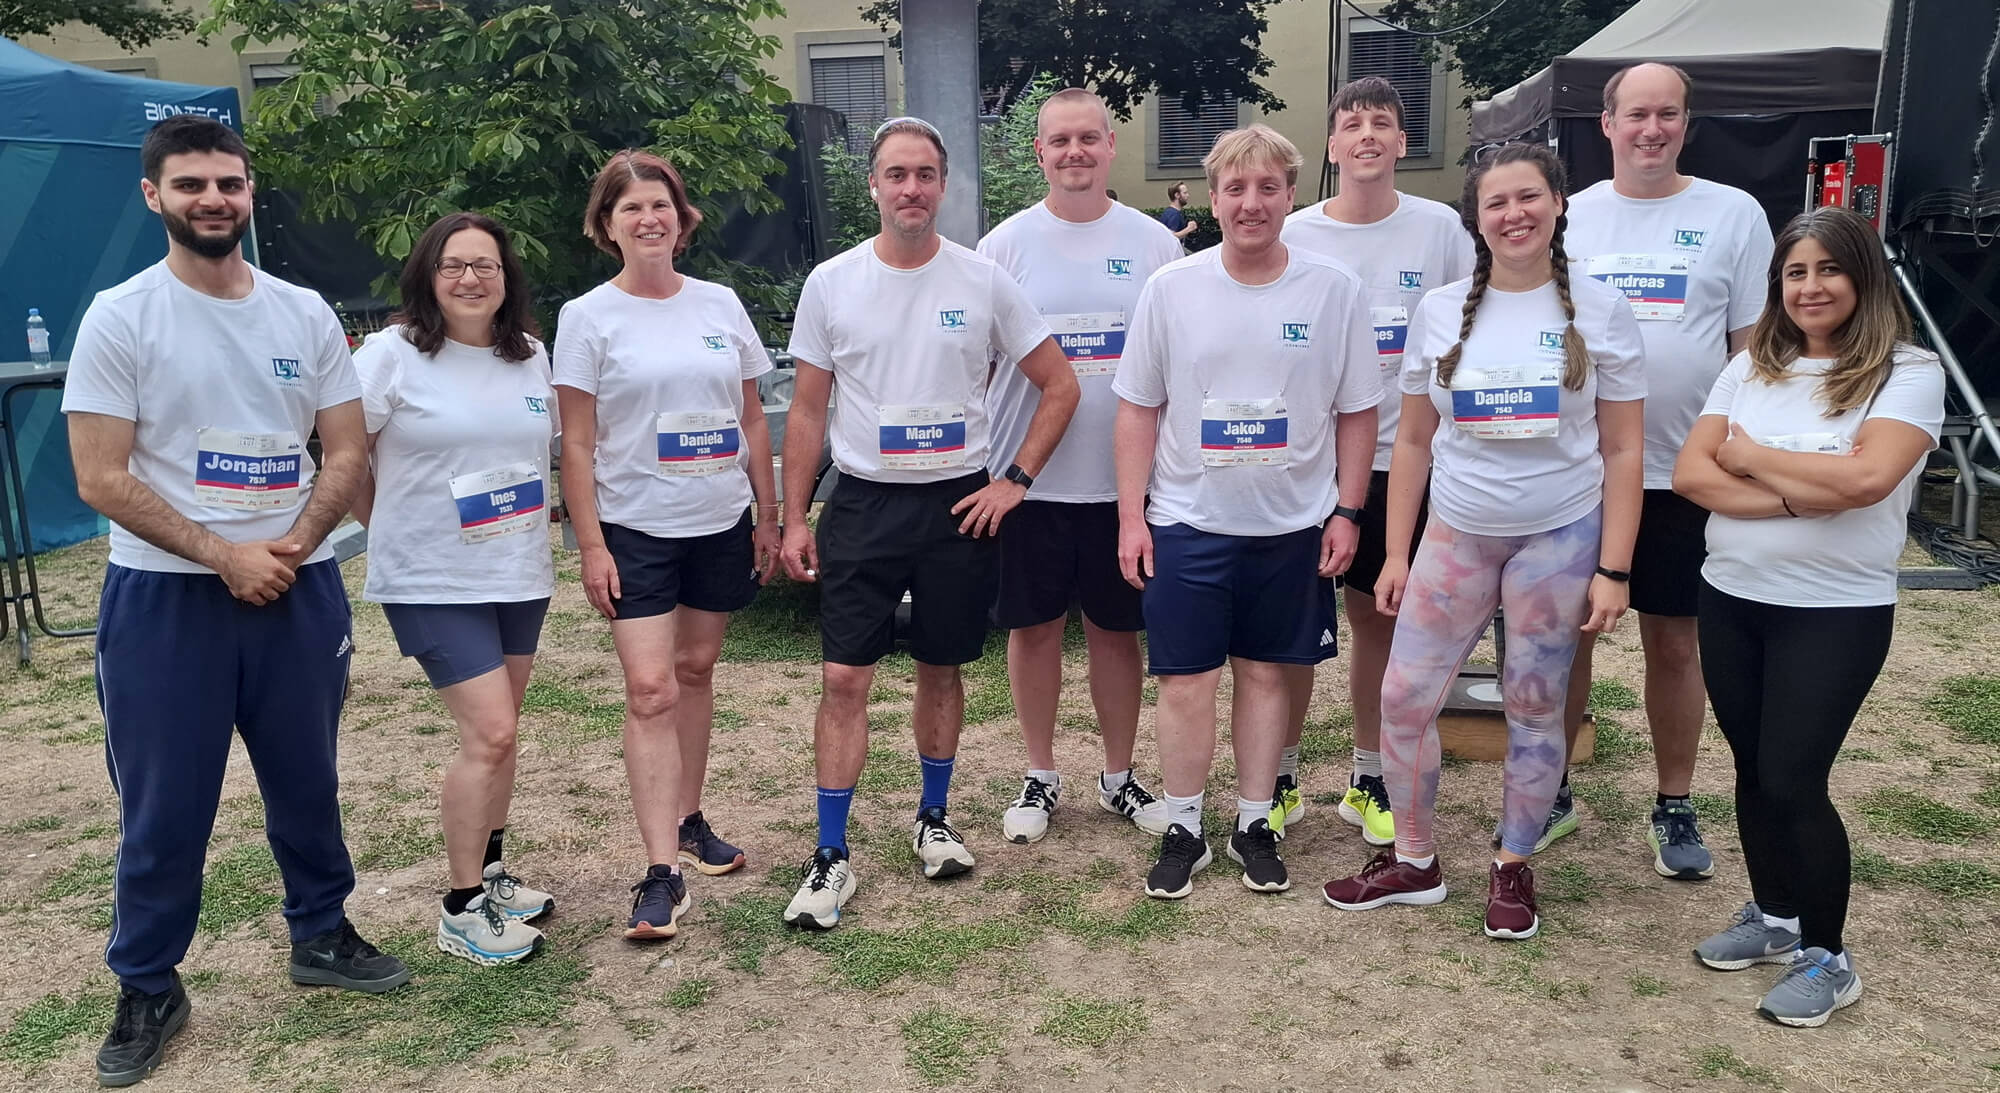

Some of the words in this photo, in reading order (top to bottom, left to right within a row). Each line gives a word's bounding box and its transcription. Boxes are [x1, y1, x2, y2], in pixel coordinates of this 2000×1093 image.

[1606, 275, 1666, 288] Andreas
[1061, 334, 1106, 347] Helmut
[1475, 389, 1533, 405] Daniela
[905, 426, 943, 440] Mario
[1223, 422, 1265, 435] Jakob
[679, 432, 723, 446] Daniela
[205, 454, 296, 474] Jonathan
[490, 490, 517, 507] Ines
